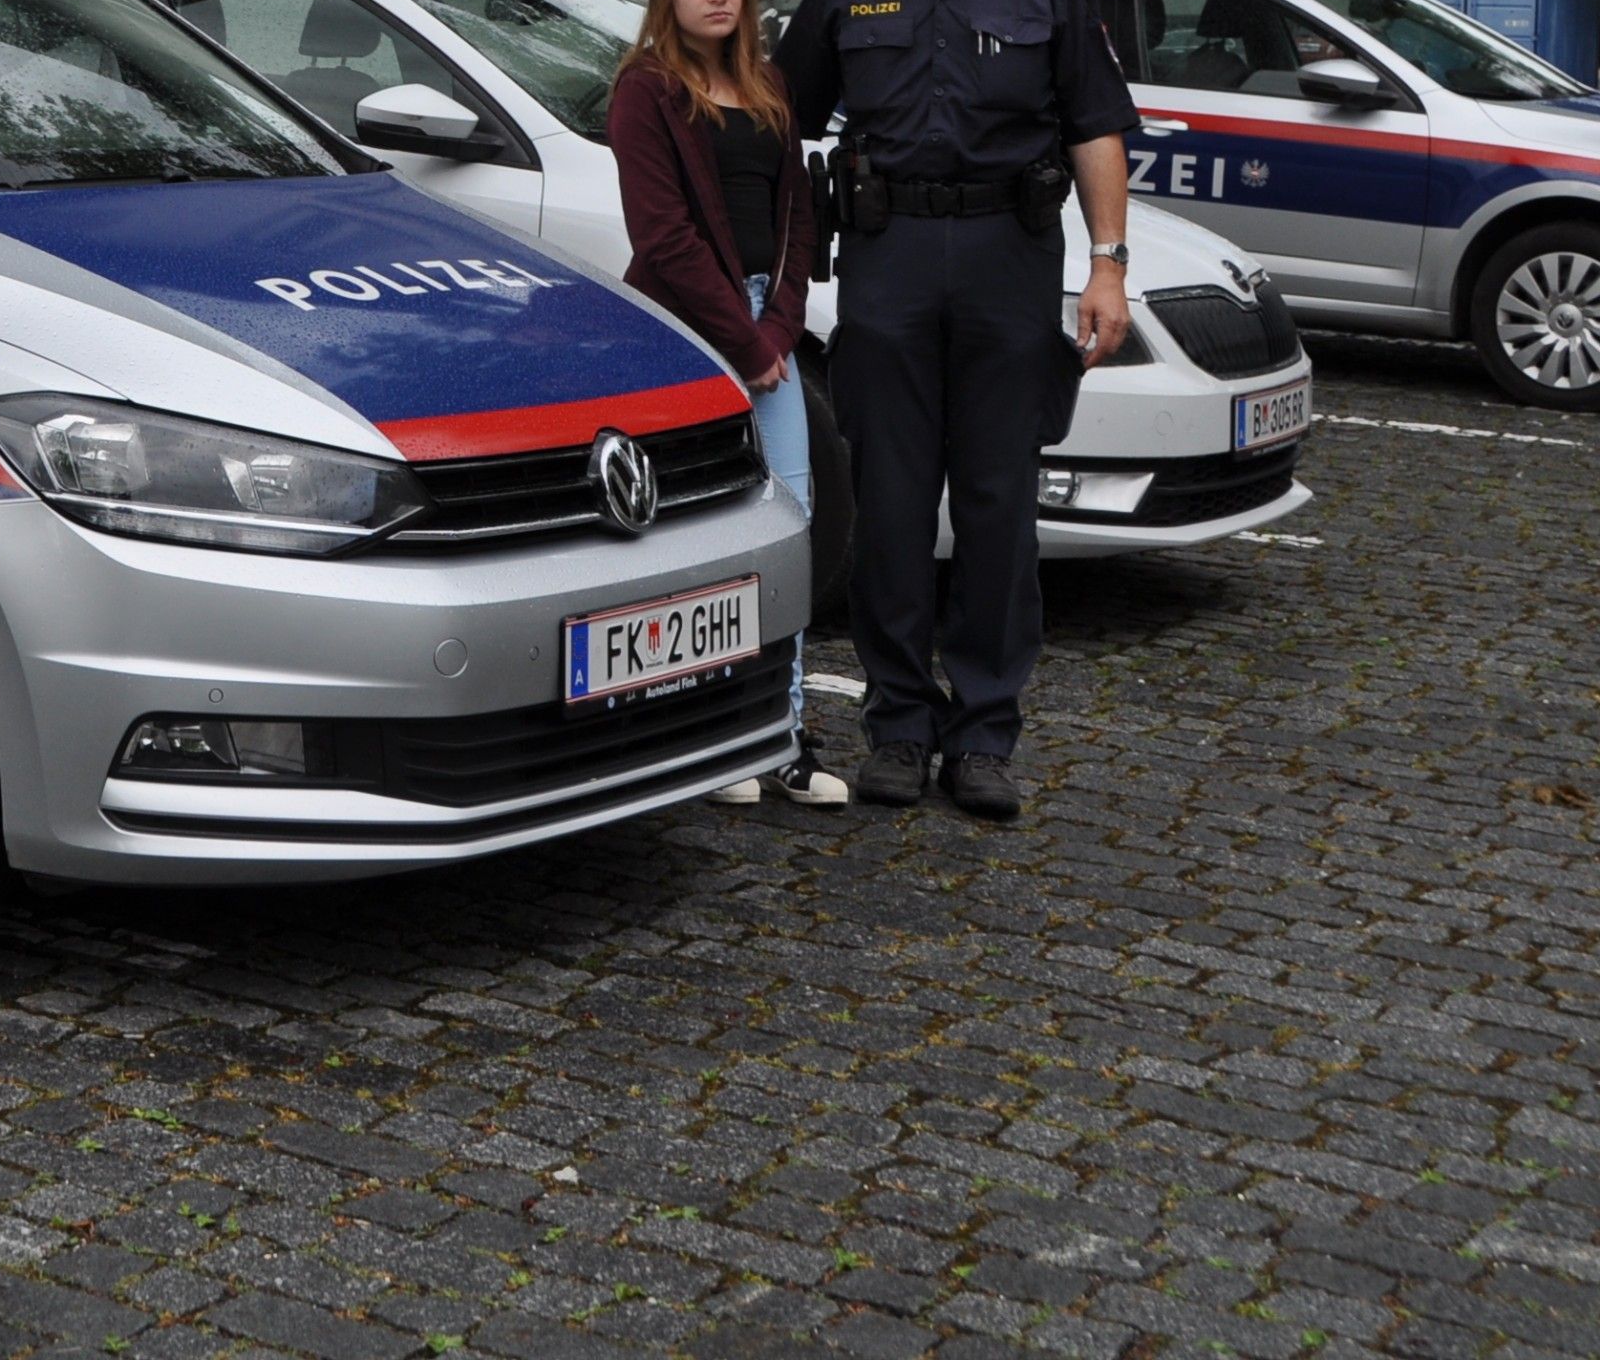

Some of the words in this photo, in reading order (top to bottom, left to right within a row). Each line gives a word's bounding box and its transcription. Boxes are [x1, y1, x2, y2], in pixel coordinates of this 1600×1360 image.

[850, 1, 901, 16] POLIZEI
[254, 259, 553, 311] POLIZEI
[606, 618, 644, 681] FK
[667, 611, 683, 664] 2
[691, 595, 741, 657] GHH
[574, 668, 585, 687] A
[645, 679, 680, 699] Autoland
[681, 674, 698, 690] Fink
